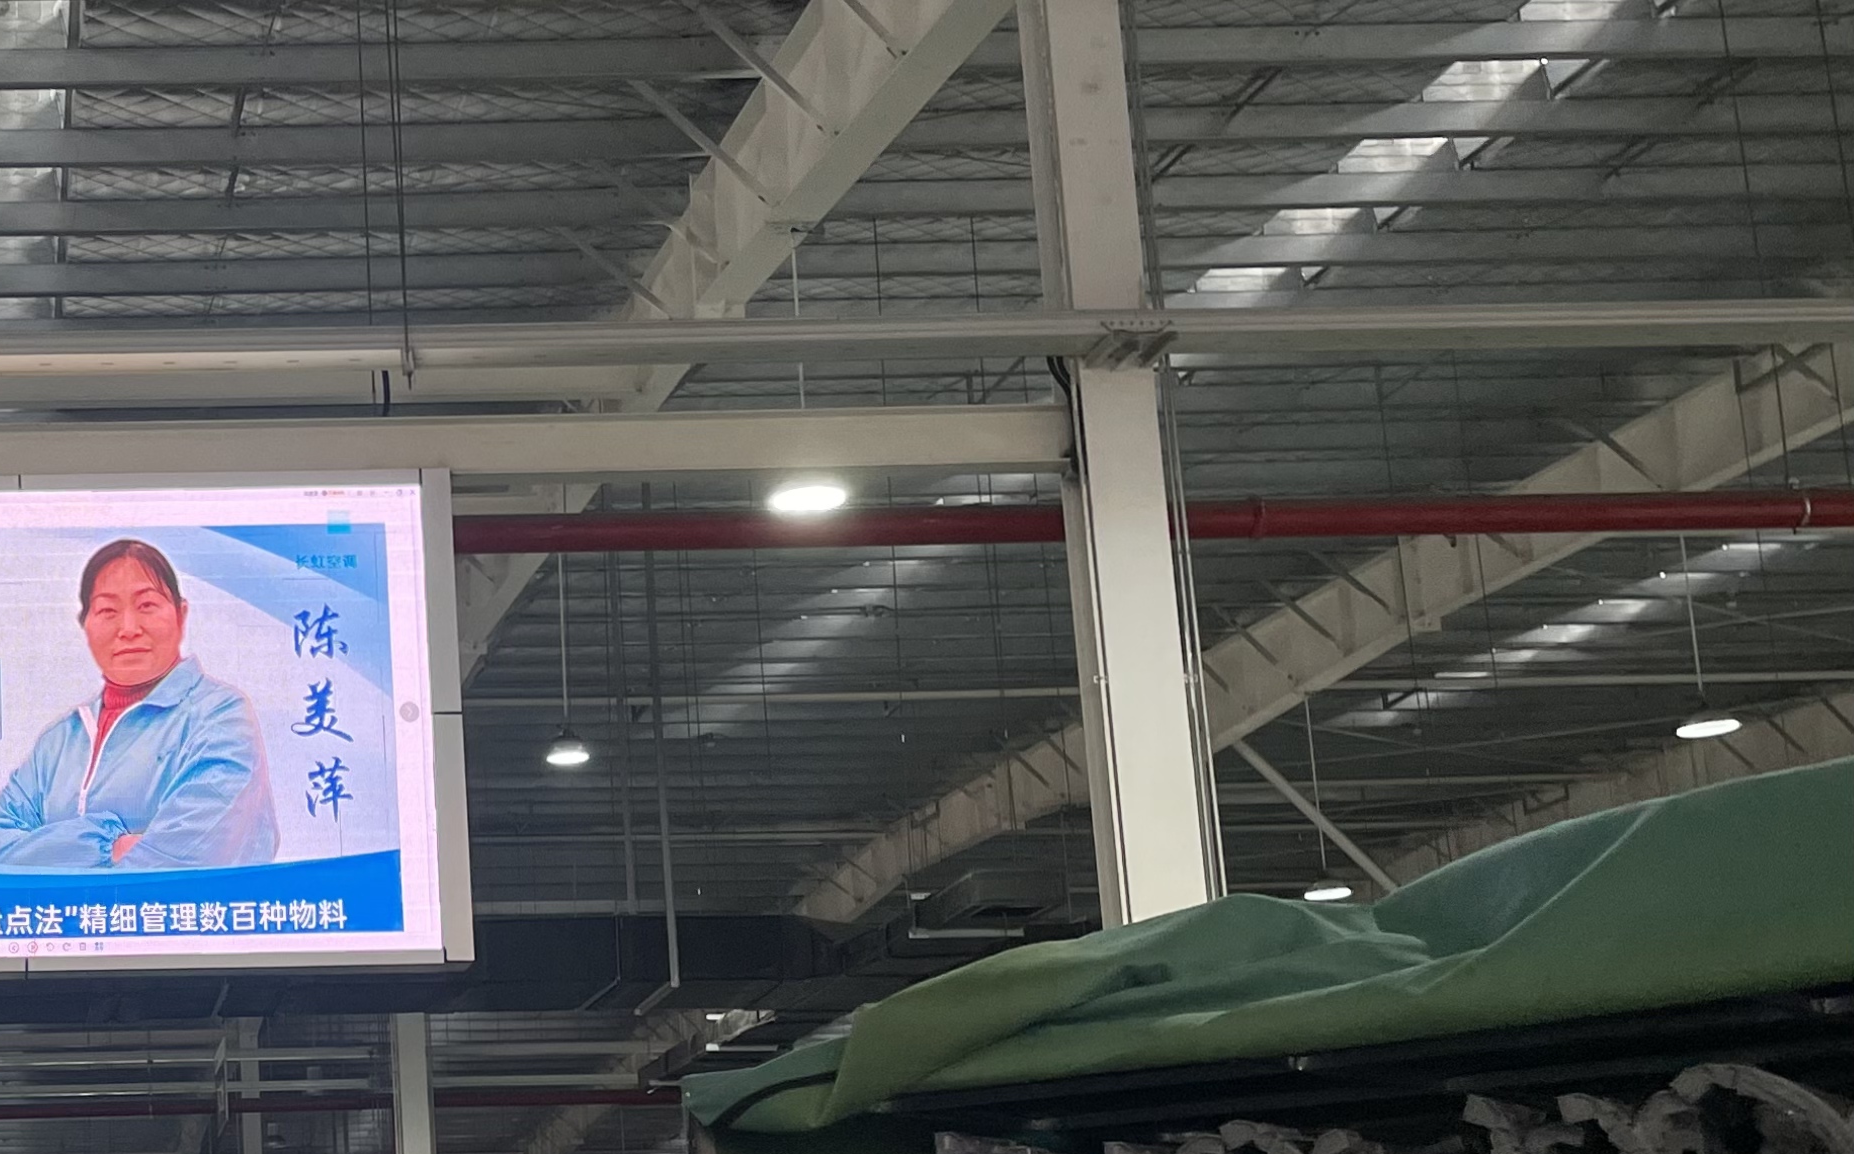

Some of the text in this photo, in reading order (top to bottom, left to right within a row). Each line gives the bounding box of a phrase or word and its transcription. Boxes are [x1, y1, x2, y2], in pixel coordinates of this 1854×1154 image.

[296, 554, 358, 570] 长虹空调
[292, 604, 355, 822] 陈美萍
